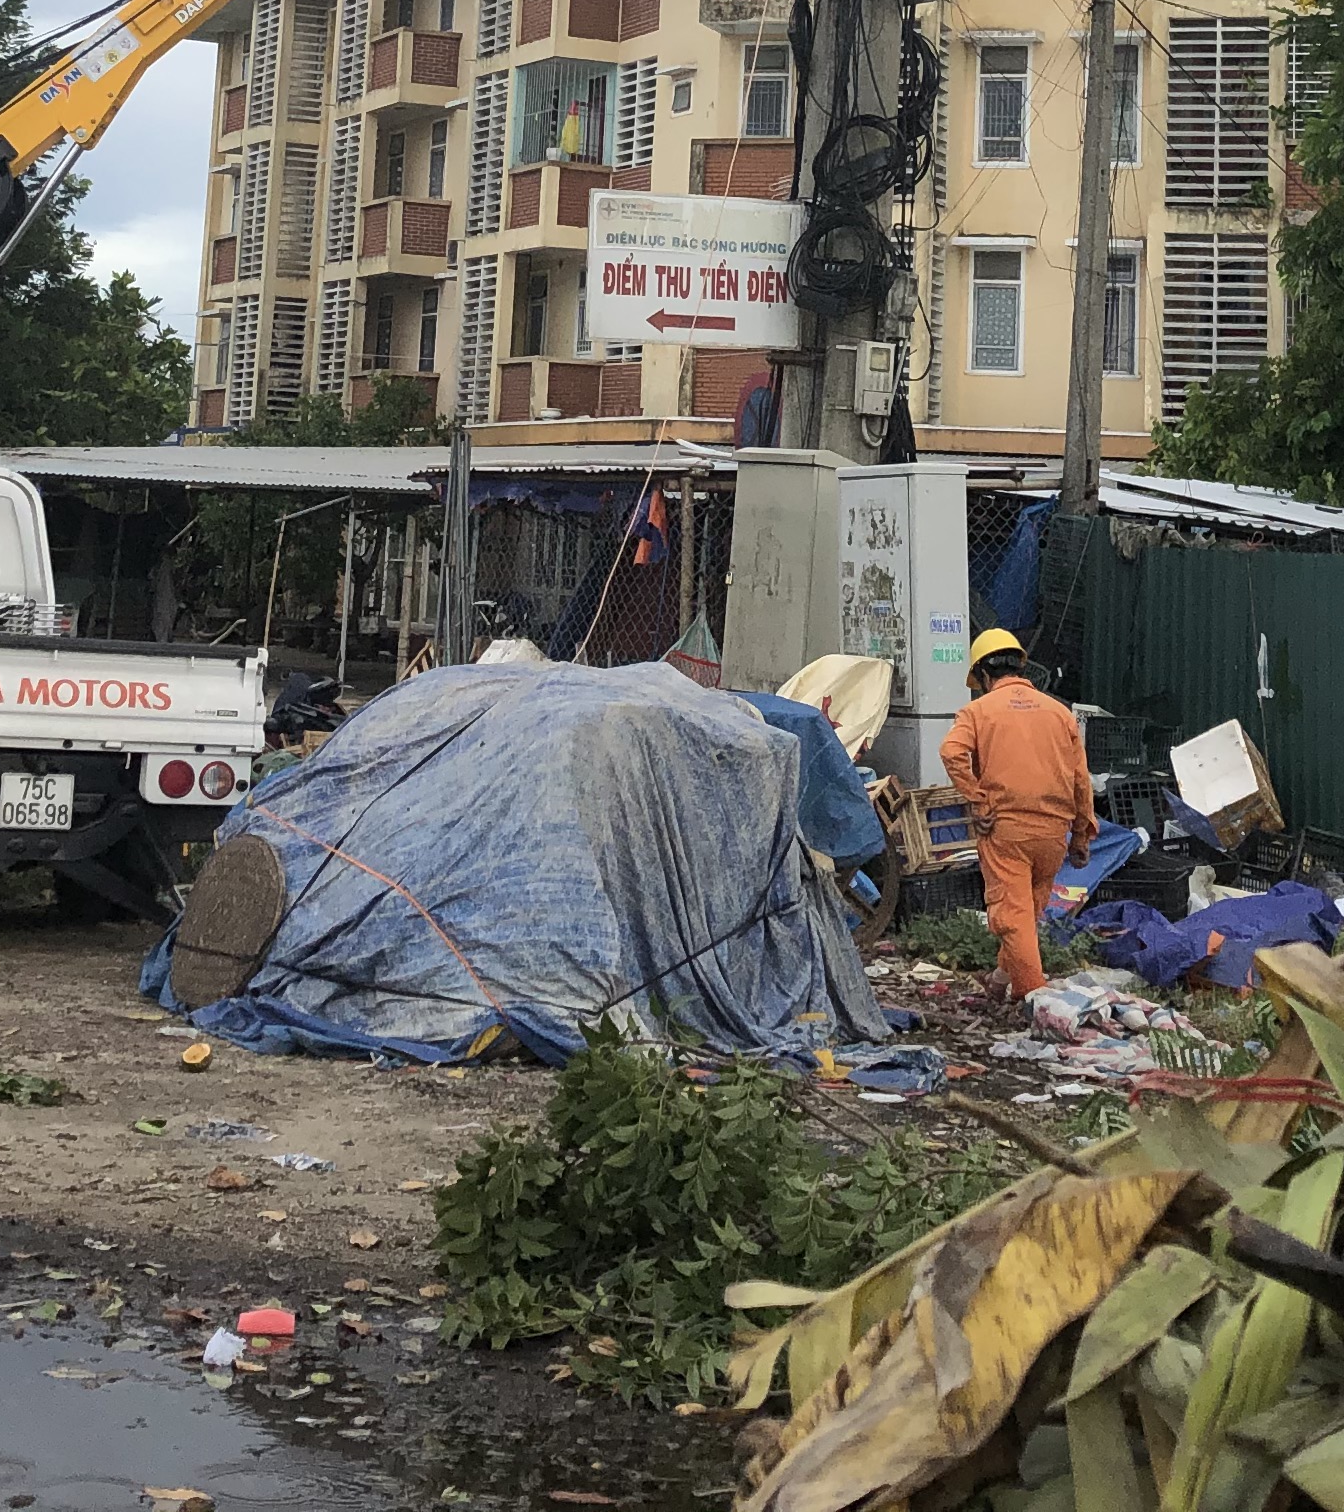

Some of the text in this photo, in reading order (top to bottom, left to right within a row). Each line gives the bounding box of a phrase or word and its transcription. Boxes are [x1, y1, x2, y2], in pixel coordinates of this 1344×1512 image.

[39, 67, 83, 104] DASAN
[603, 252, 788, 309] ĐIỂM THU TIỀN ĐIỆN
[17, 676, 172, 711] MOTORS
[19, 777, 57, 801] 75C
[2, 802, 69, 826] 065.98
